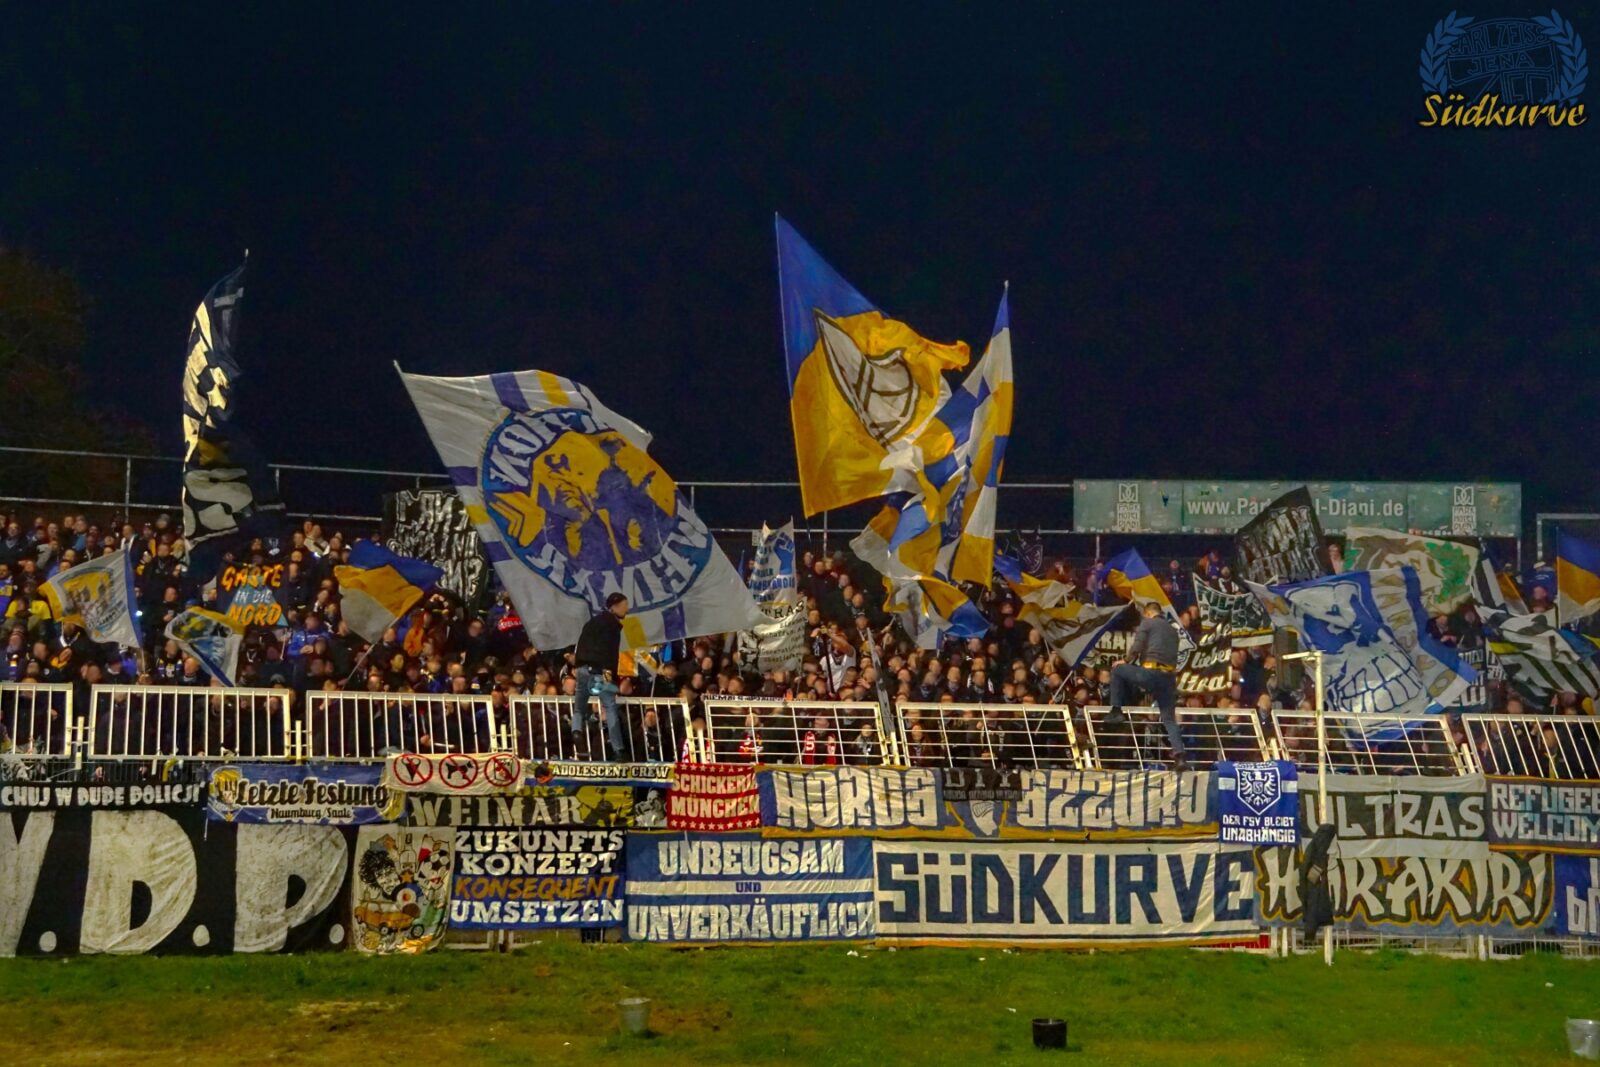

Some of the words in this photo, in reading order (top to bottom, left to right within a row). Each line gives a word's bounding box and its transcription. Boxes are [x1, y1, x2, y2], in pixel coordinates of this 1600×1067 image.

[229, 602, 282, 626] NORD
[1176, 665, 1233, 693] ltra!
[552, 763, 629, 777] ADOLESCENT
[631, 765, 670, 778] CREW
[1, 785, 50, 806] CHUJ
[55, 787, 73, 806] W
[77, 785, 125, 806] DUPE
[235, 779, 300, 806] Letzte
[303, 777, 390, 809] Festung
[671, 794, 760, 818] MÜNCHEN
[407, 795, 585, 828] WEIMAR
[1222, 814, 1240, 825] DER
[1243, 815, 1261, 827] FSV
[1264, 816, 1295, 827] BLEIBT
[1305, 791, 1486, 838] ULTRAS
[455, 829, 625, 853] ZUKUNFTS
[1222, 827, 1296, 843] UNABHÄNGIG
[460, 851, 617, 877] KONZEPT
[657, 839, 845, 877] UNBEUGSAM
[454, 874, 619, 900] KONSEQUENT
[735, 882, 761, 893] UND
[876, 853, 1254, 925] SÜDKURVE
[450, 898, 625, 925] UMSETZEN
[627, 898, 875, 943] UNVERKÄUFLICH
